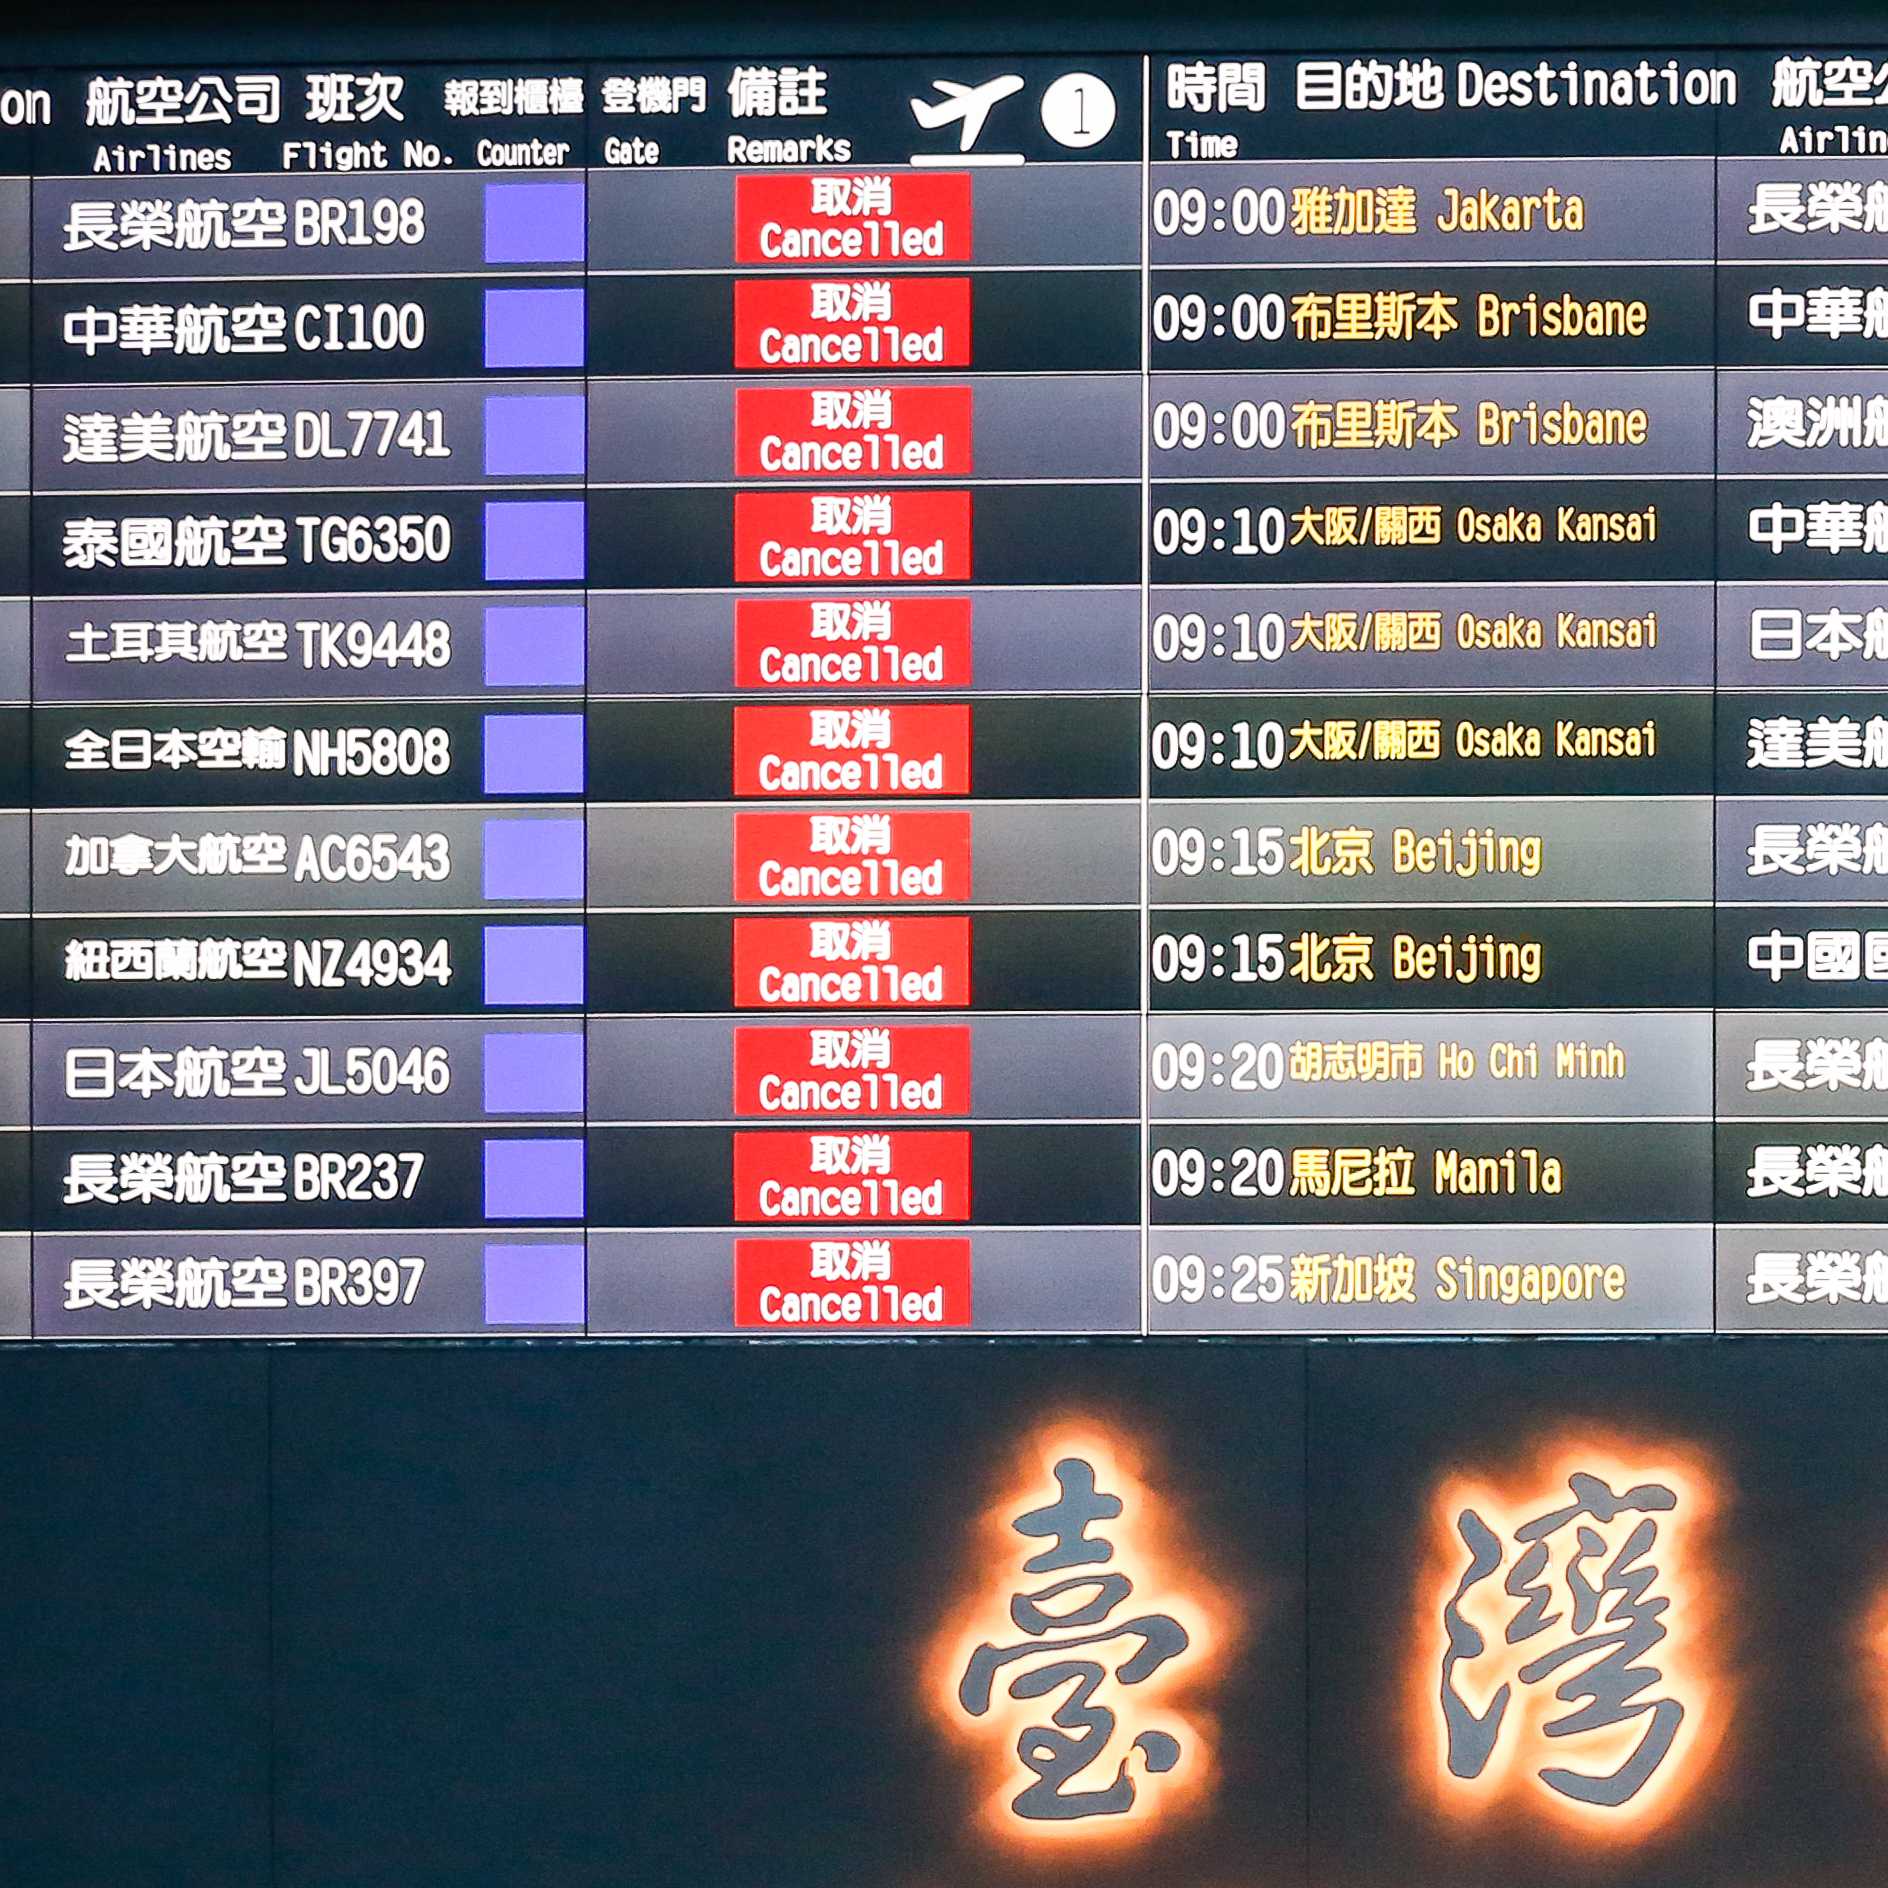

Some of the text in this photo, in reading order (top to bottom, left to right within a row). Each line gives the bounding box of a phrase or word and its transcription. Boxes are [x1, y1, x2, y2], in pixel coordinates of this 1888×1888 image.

[86, 75, 280, 126] 航空公司
[306, 72, 404, 123] 班次
[444, 77, 584, 116] 報到櫃檯
[601, 76, 706, 114] 登機門
[727, 65, 827, 118] 備註
[1168, 58, 1736, 113] 時間 目的地 Destination
[93, 134, 851, 174] Airlines Flight No. Counter Gate Remarks
[1166, 130, 1238, 159] Time
[810, 176, 892, 214] 取消
[1153, 188, 1286, 236] 09:00
[1290, 185, 1417, 235] 雅加達
[1437, 187, 1584, 232] Jakarta
[63, 197, 425, 251] 長榮航空 BR198
[759, 220, 943, 259] Cancelled
[1153, 507, 1285, 555] 09:10
[1290, 505, 1442, 546] 大阪/關西
[1457, 507, 1542, 542] Osaka
[1558, 506, 1656, 542] Kansai
[65, 619, 451, 668] 土耳其航空 TK9448
[65, 937, 452, 987] 紐西蘭航空 NZ4934
[1152, 933, 1285, 982] 09:15
[1289, 932, 1374, 983] 北京
[1393, 934, 1541, 983] Beijing
